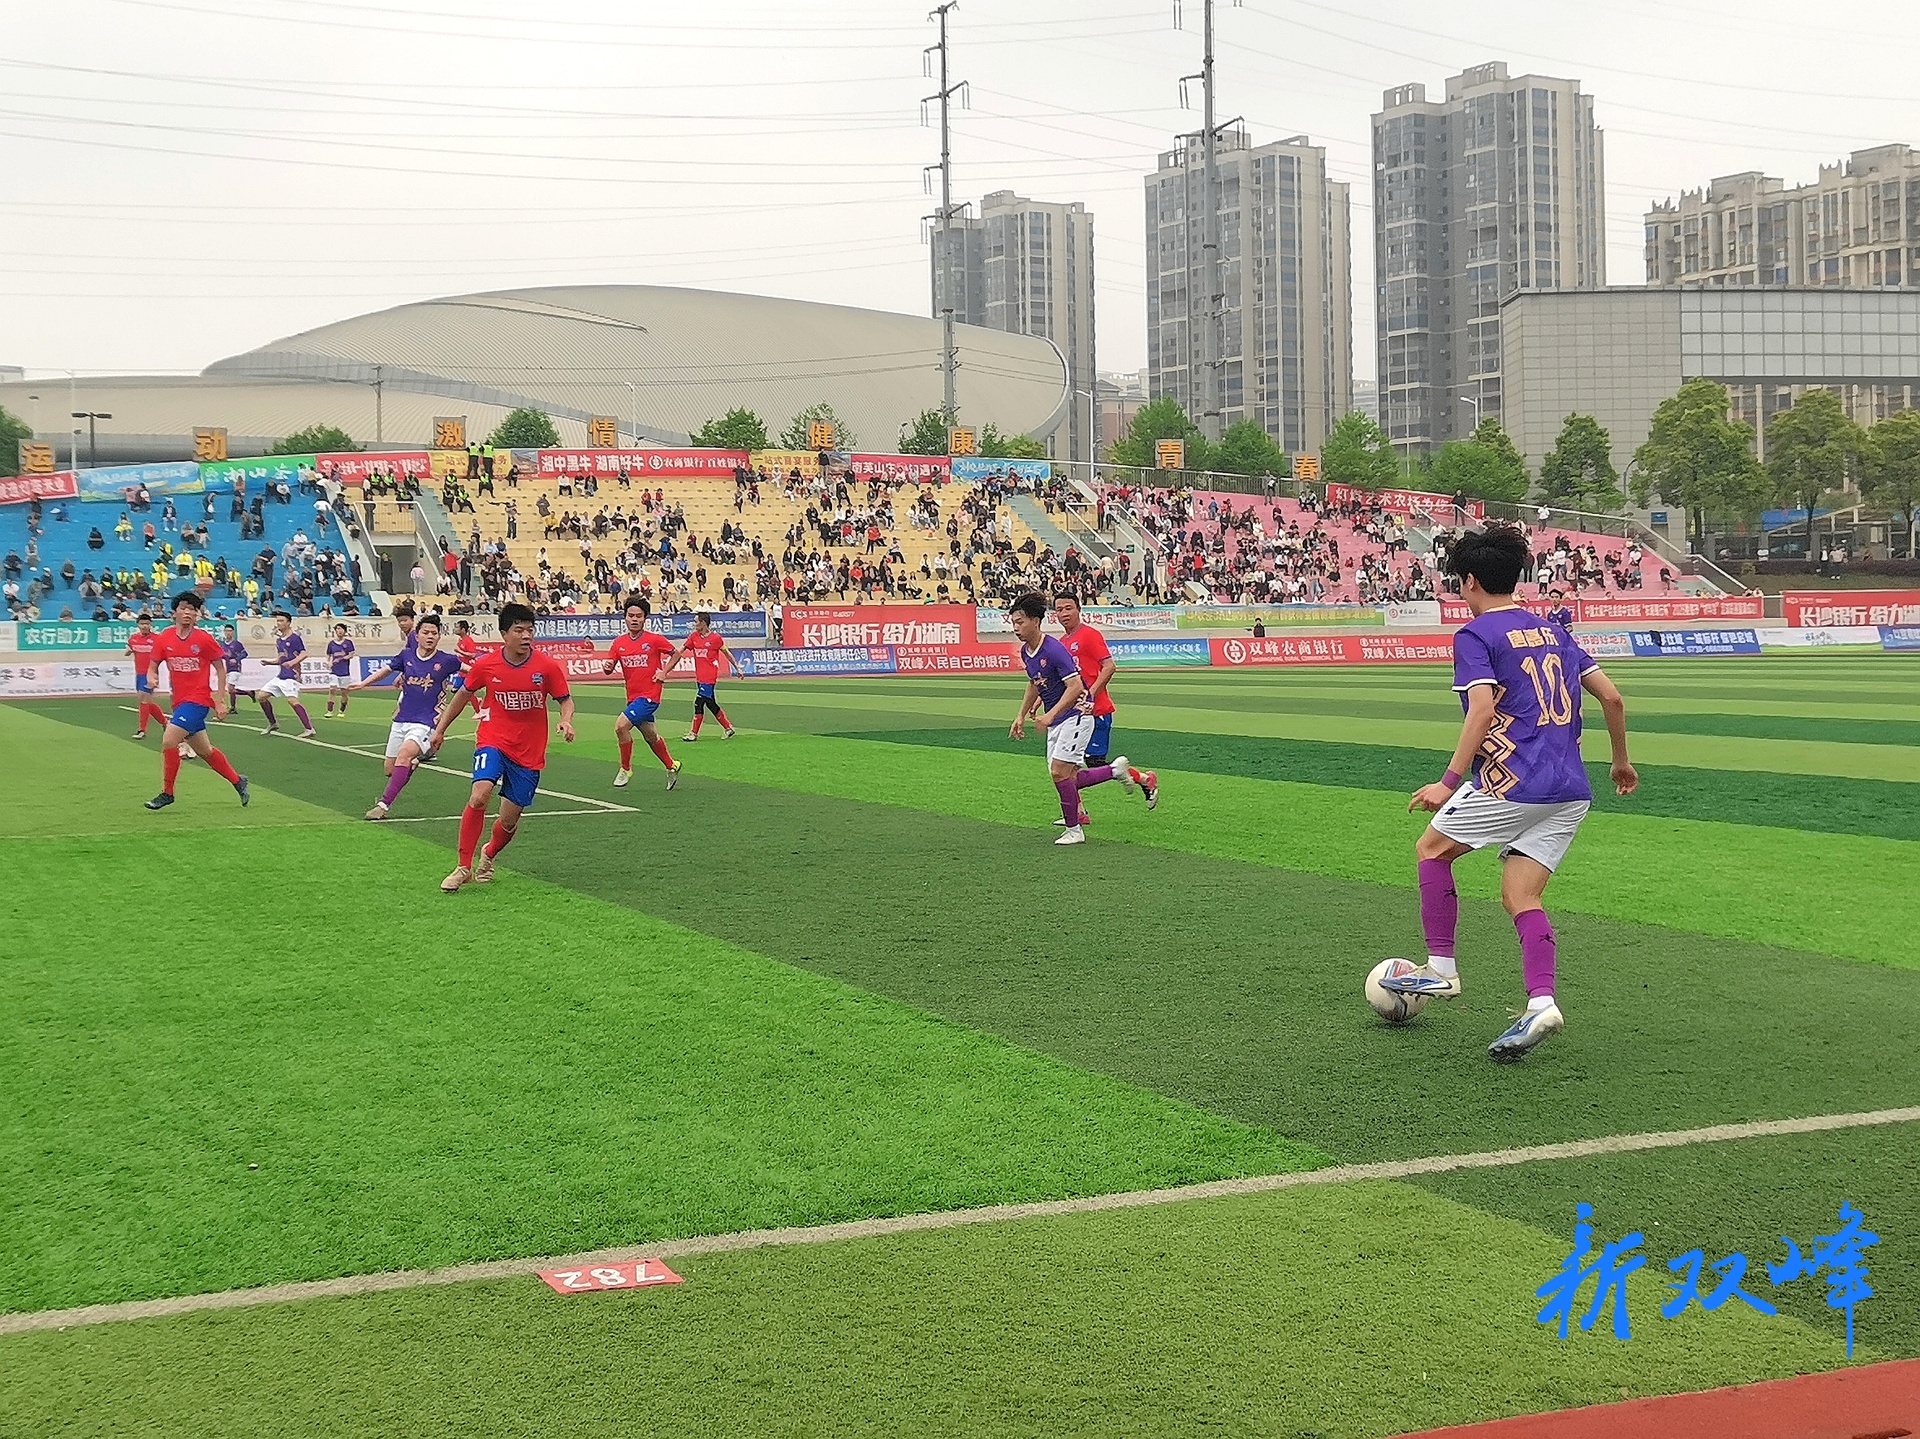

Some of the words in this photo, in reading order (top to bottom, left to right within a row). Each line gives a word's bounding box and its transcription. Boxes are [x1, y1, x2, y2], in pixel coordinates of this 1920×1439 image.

[22, 443, 55, 472] 运
[196, 429, 227, 460] 动
[436, 421, 464, 447] 激
[589, 419, 615, 447] 情
[808, 421, 834, 448] 健
[951, 428, 975, 454] 康
[1158, 441, 1183, 469] 青
[1294, 455, 1320, 481] 春
[1799, 606, 1868, 627] 长沙银行
[534, 617, 672, 637] 双峰县城乡发展集公司
[802, 623, 880, 647] 长沙银行
[882, 620, 960, 645] 给力湖南
[1247, 639, 1343, 656] 双峰农商银行
[899, 656, 1010, 670] 双峰人民自己的银行
[1520, 653, 1572, 727] 10
[474, 753, 488, 771] 11
